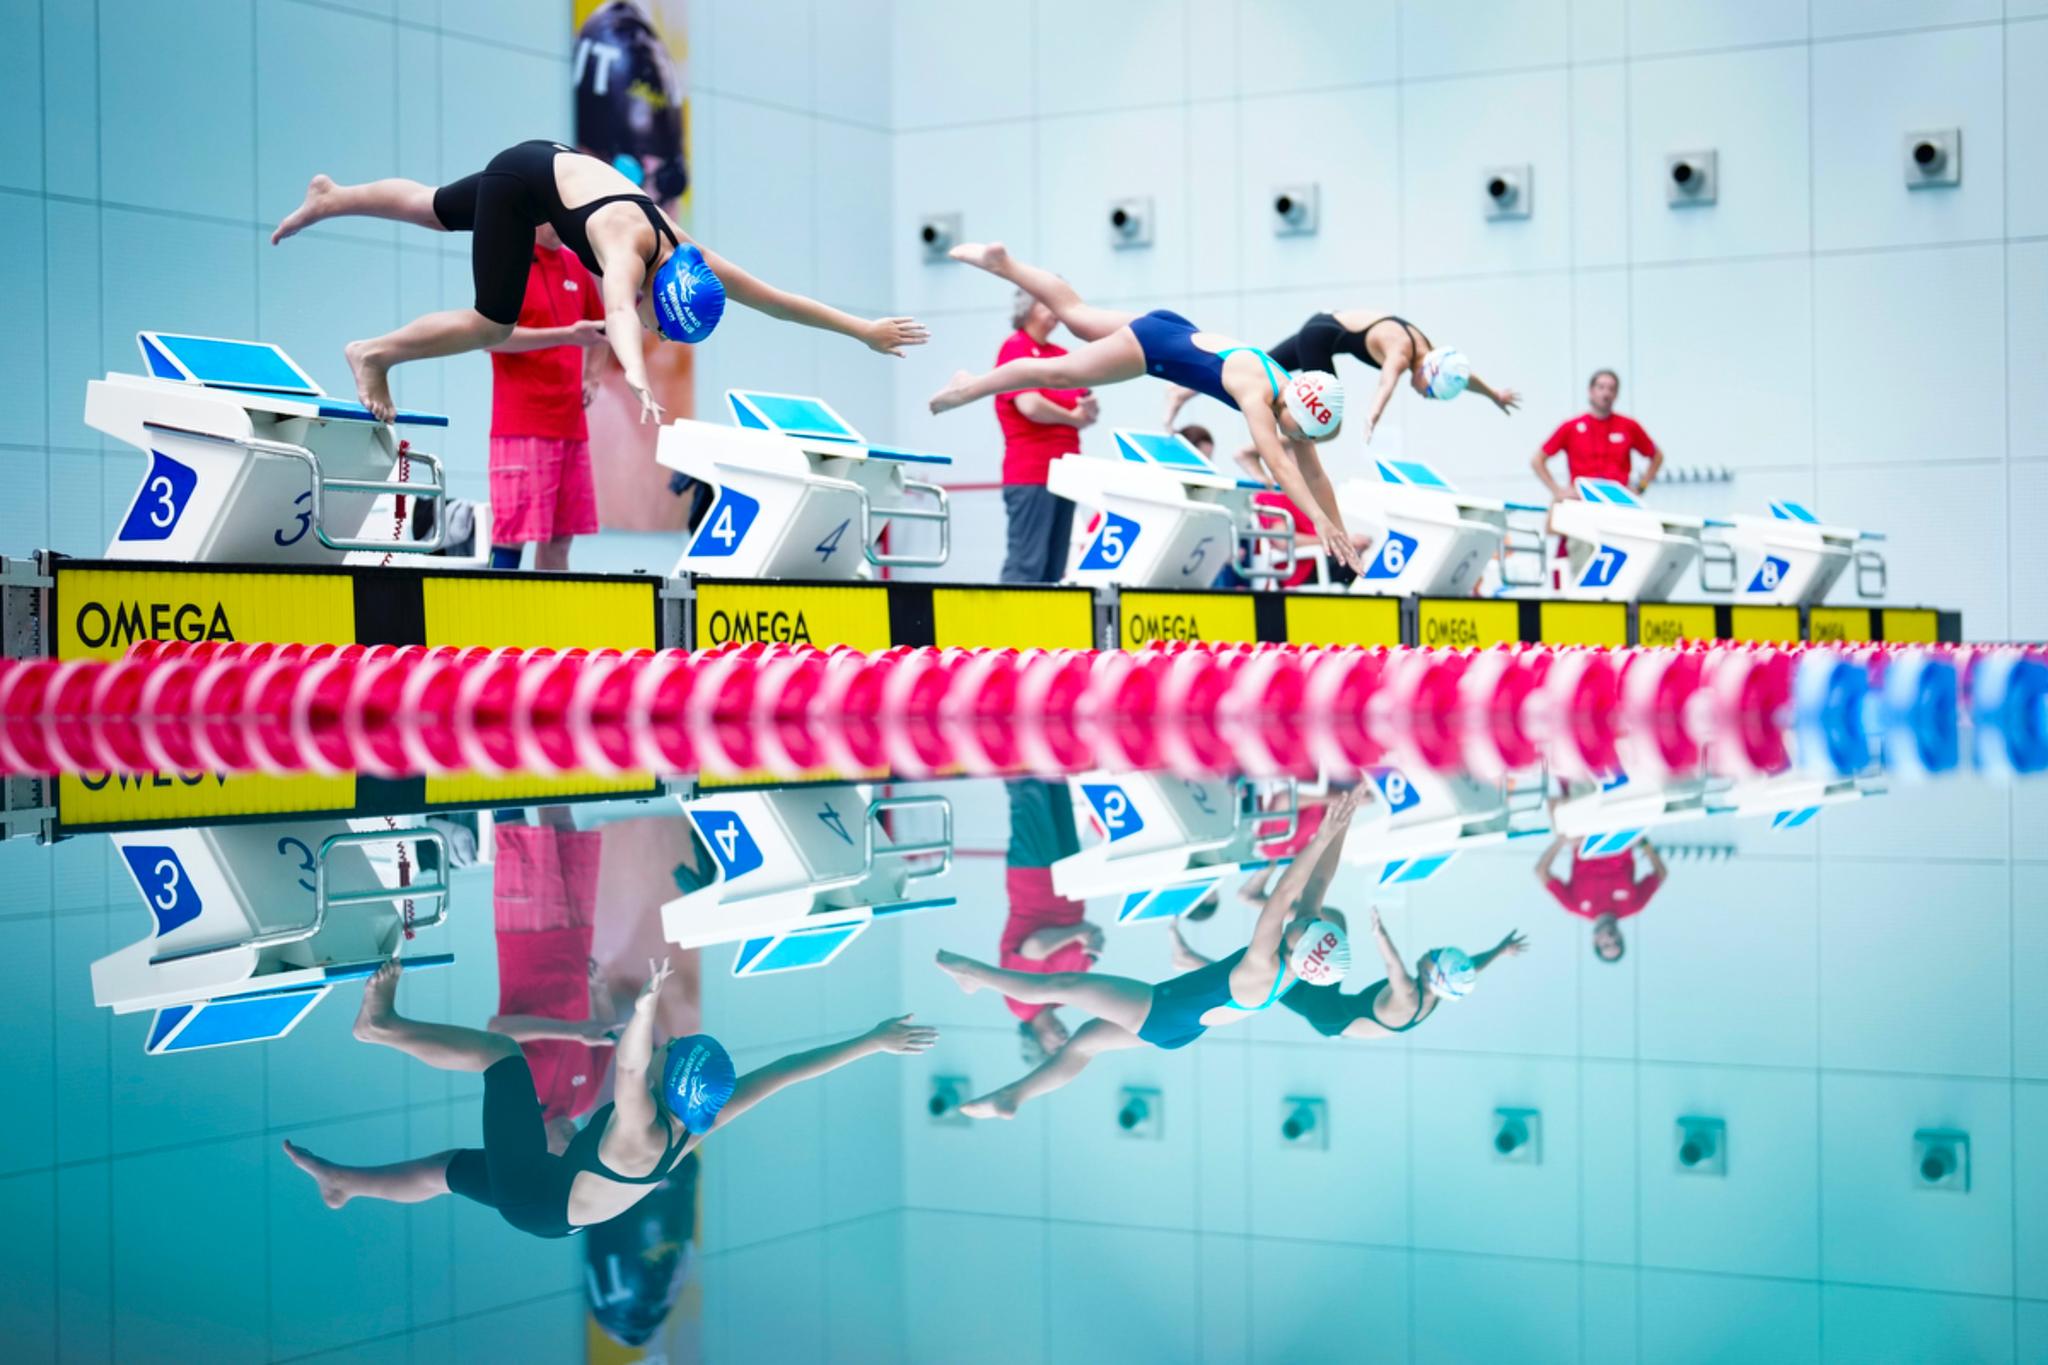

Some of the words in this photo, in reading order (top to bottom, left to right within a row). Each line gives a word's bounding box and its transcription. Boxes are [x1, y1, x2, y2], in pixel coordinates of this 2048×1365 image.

[150, 476, 176, 528] 3
[273, 490, 312, 547] 3
[711, 504, 737, 548] 4
[814, 518, 852, 563] 4
[1101, 525, 1125, 564] 5
[1181, 536, 1214, 576] 5
[1383, 538, 1406, 574] 6
[1595, 552, 1615, 583] 7
[1761, 560, 1780, 590] 8
[76, 600, 236, 648] OMEGA
[709, 608, 812, 646] OMEGA
[1130, 613, 1201, 645] OMEGA
[1426, 617, 1479, 645] OMEGA
